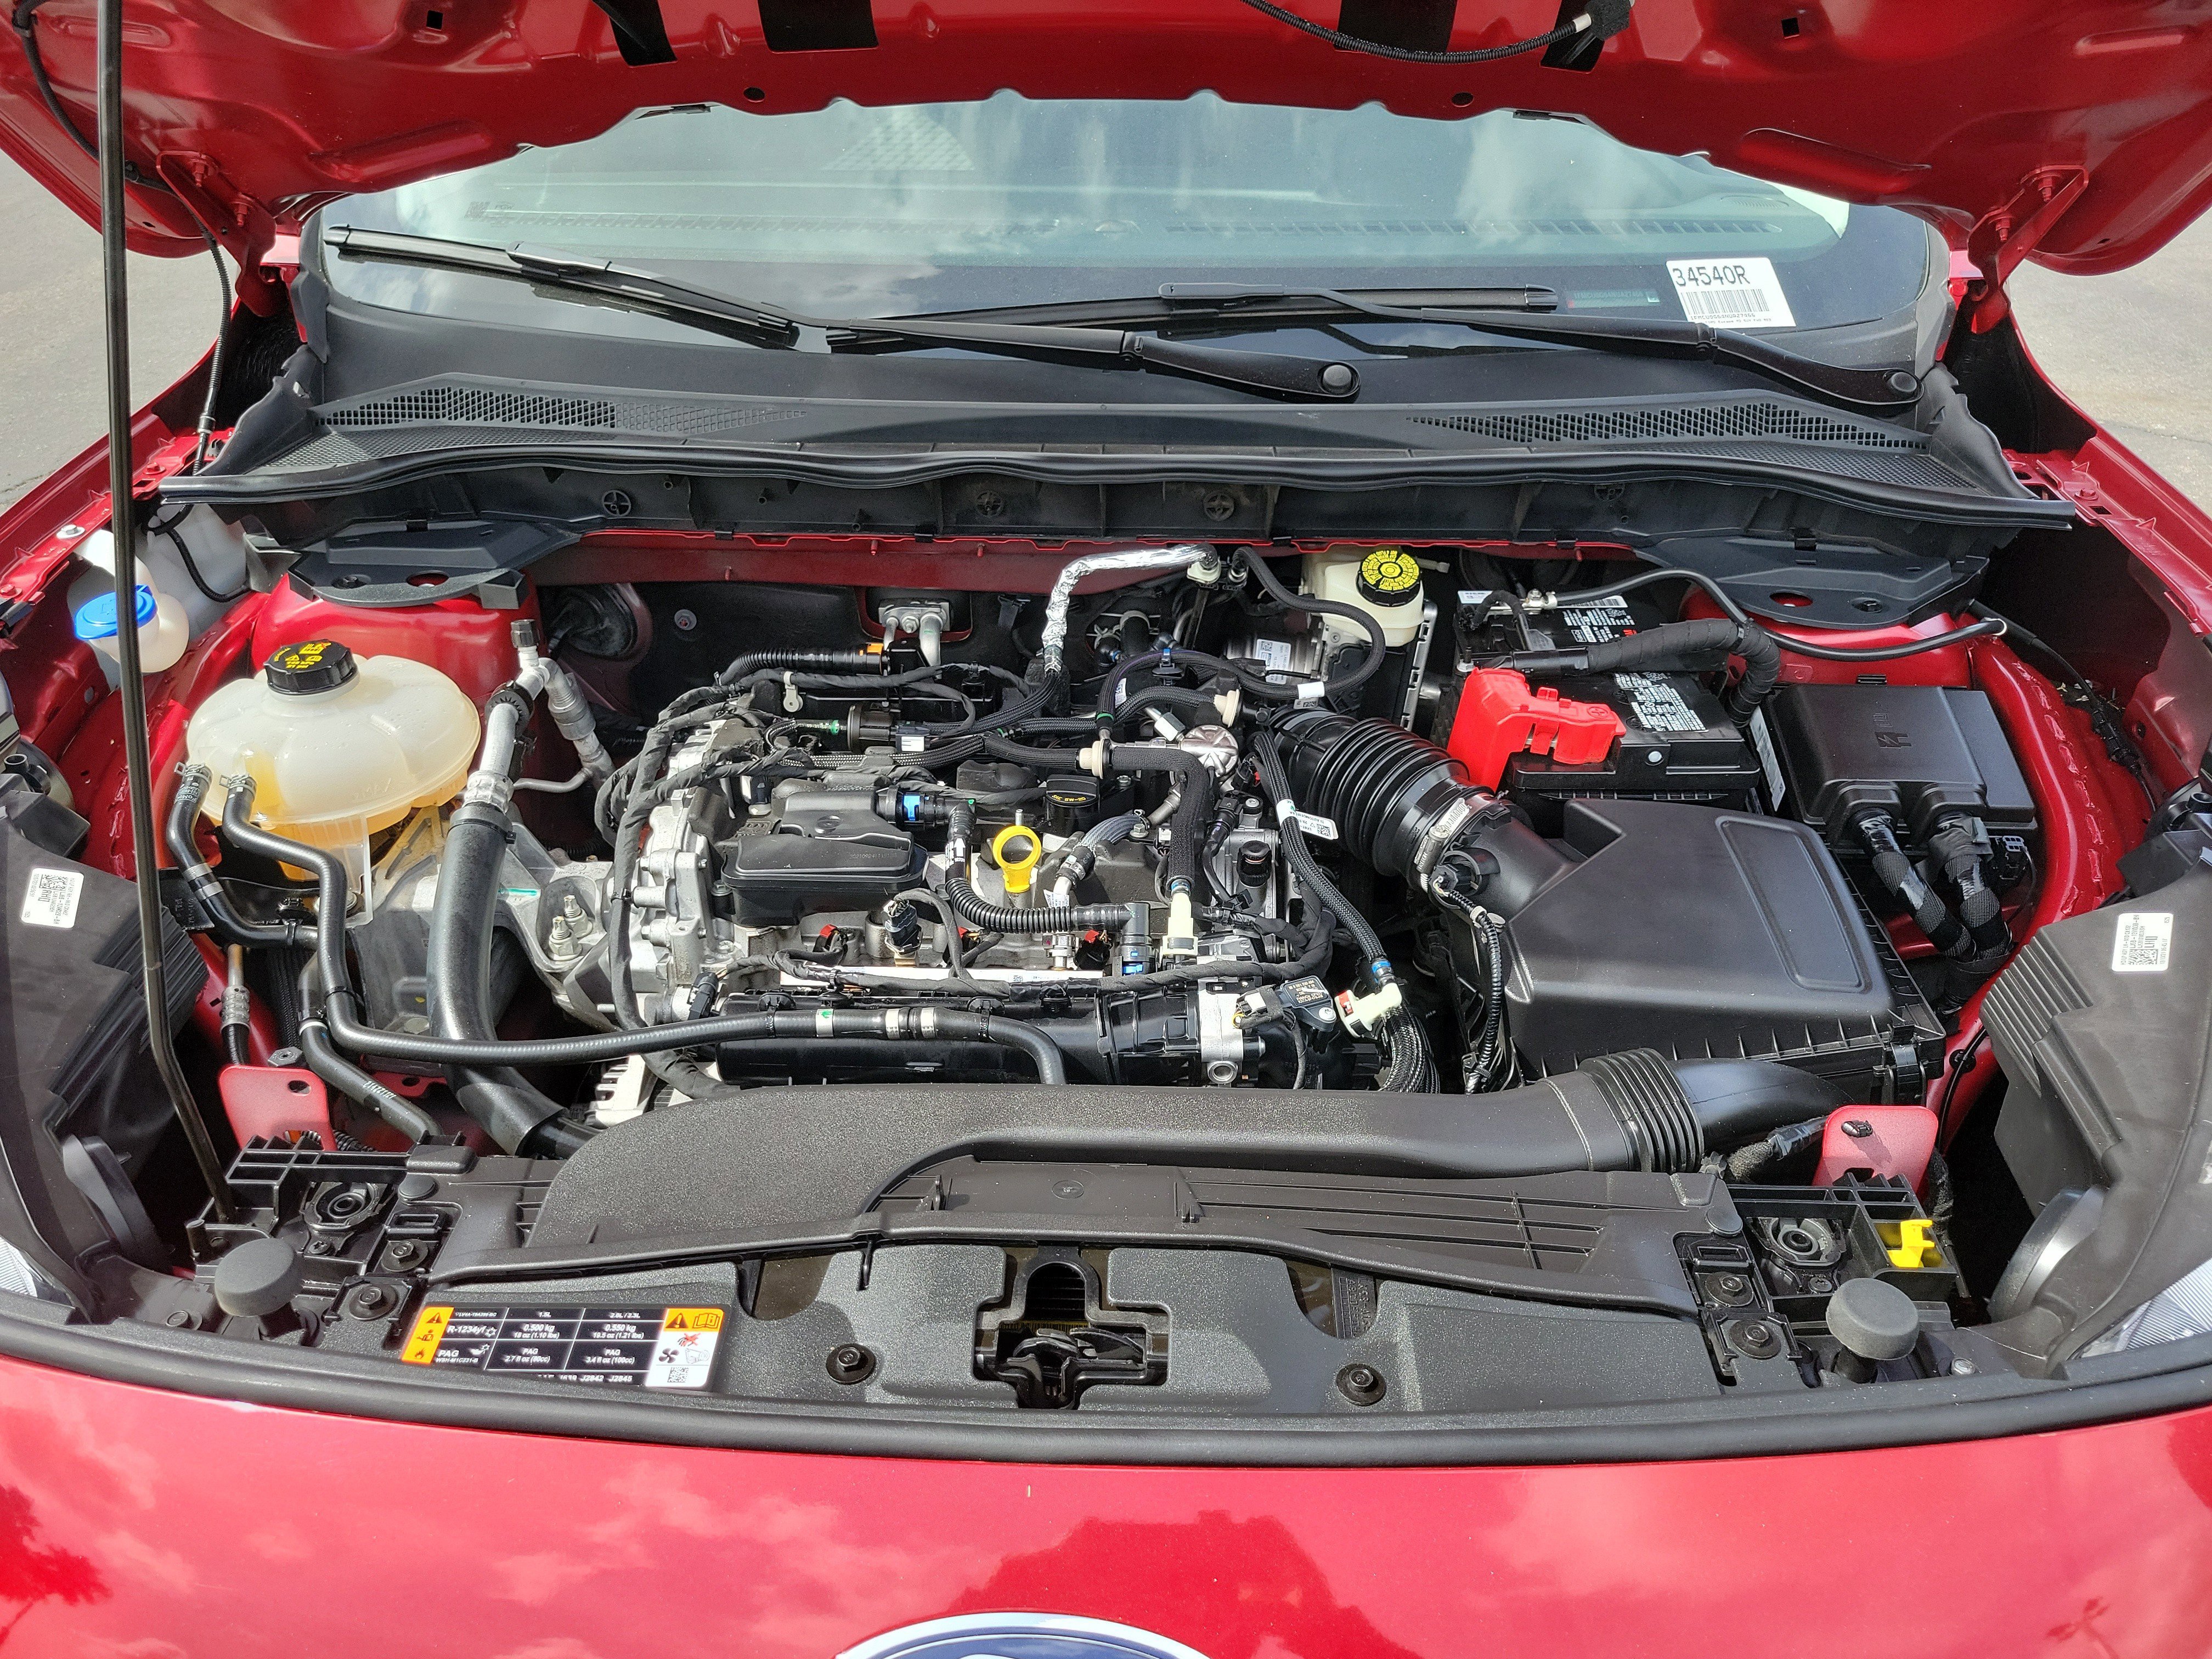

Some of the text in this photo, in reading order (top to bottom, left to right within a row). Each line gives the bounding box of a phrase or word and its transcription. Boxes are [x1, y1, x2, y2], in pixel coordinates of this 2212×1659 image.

[1672, 264, 1751, 287] 34540R
[447, 1325, 487, 1335] R-1234yf
[544, 1324, 556, 1332] kg
[625, 1324, 637, 1333] kg
[611, 1356, 635, 1364] (100cc)
